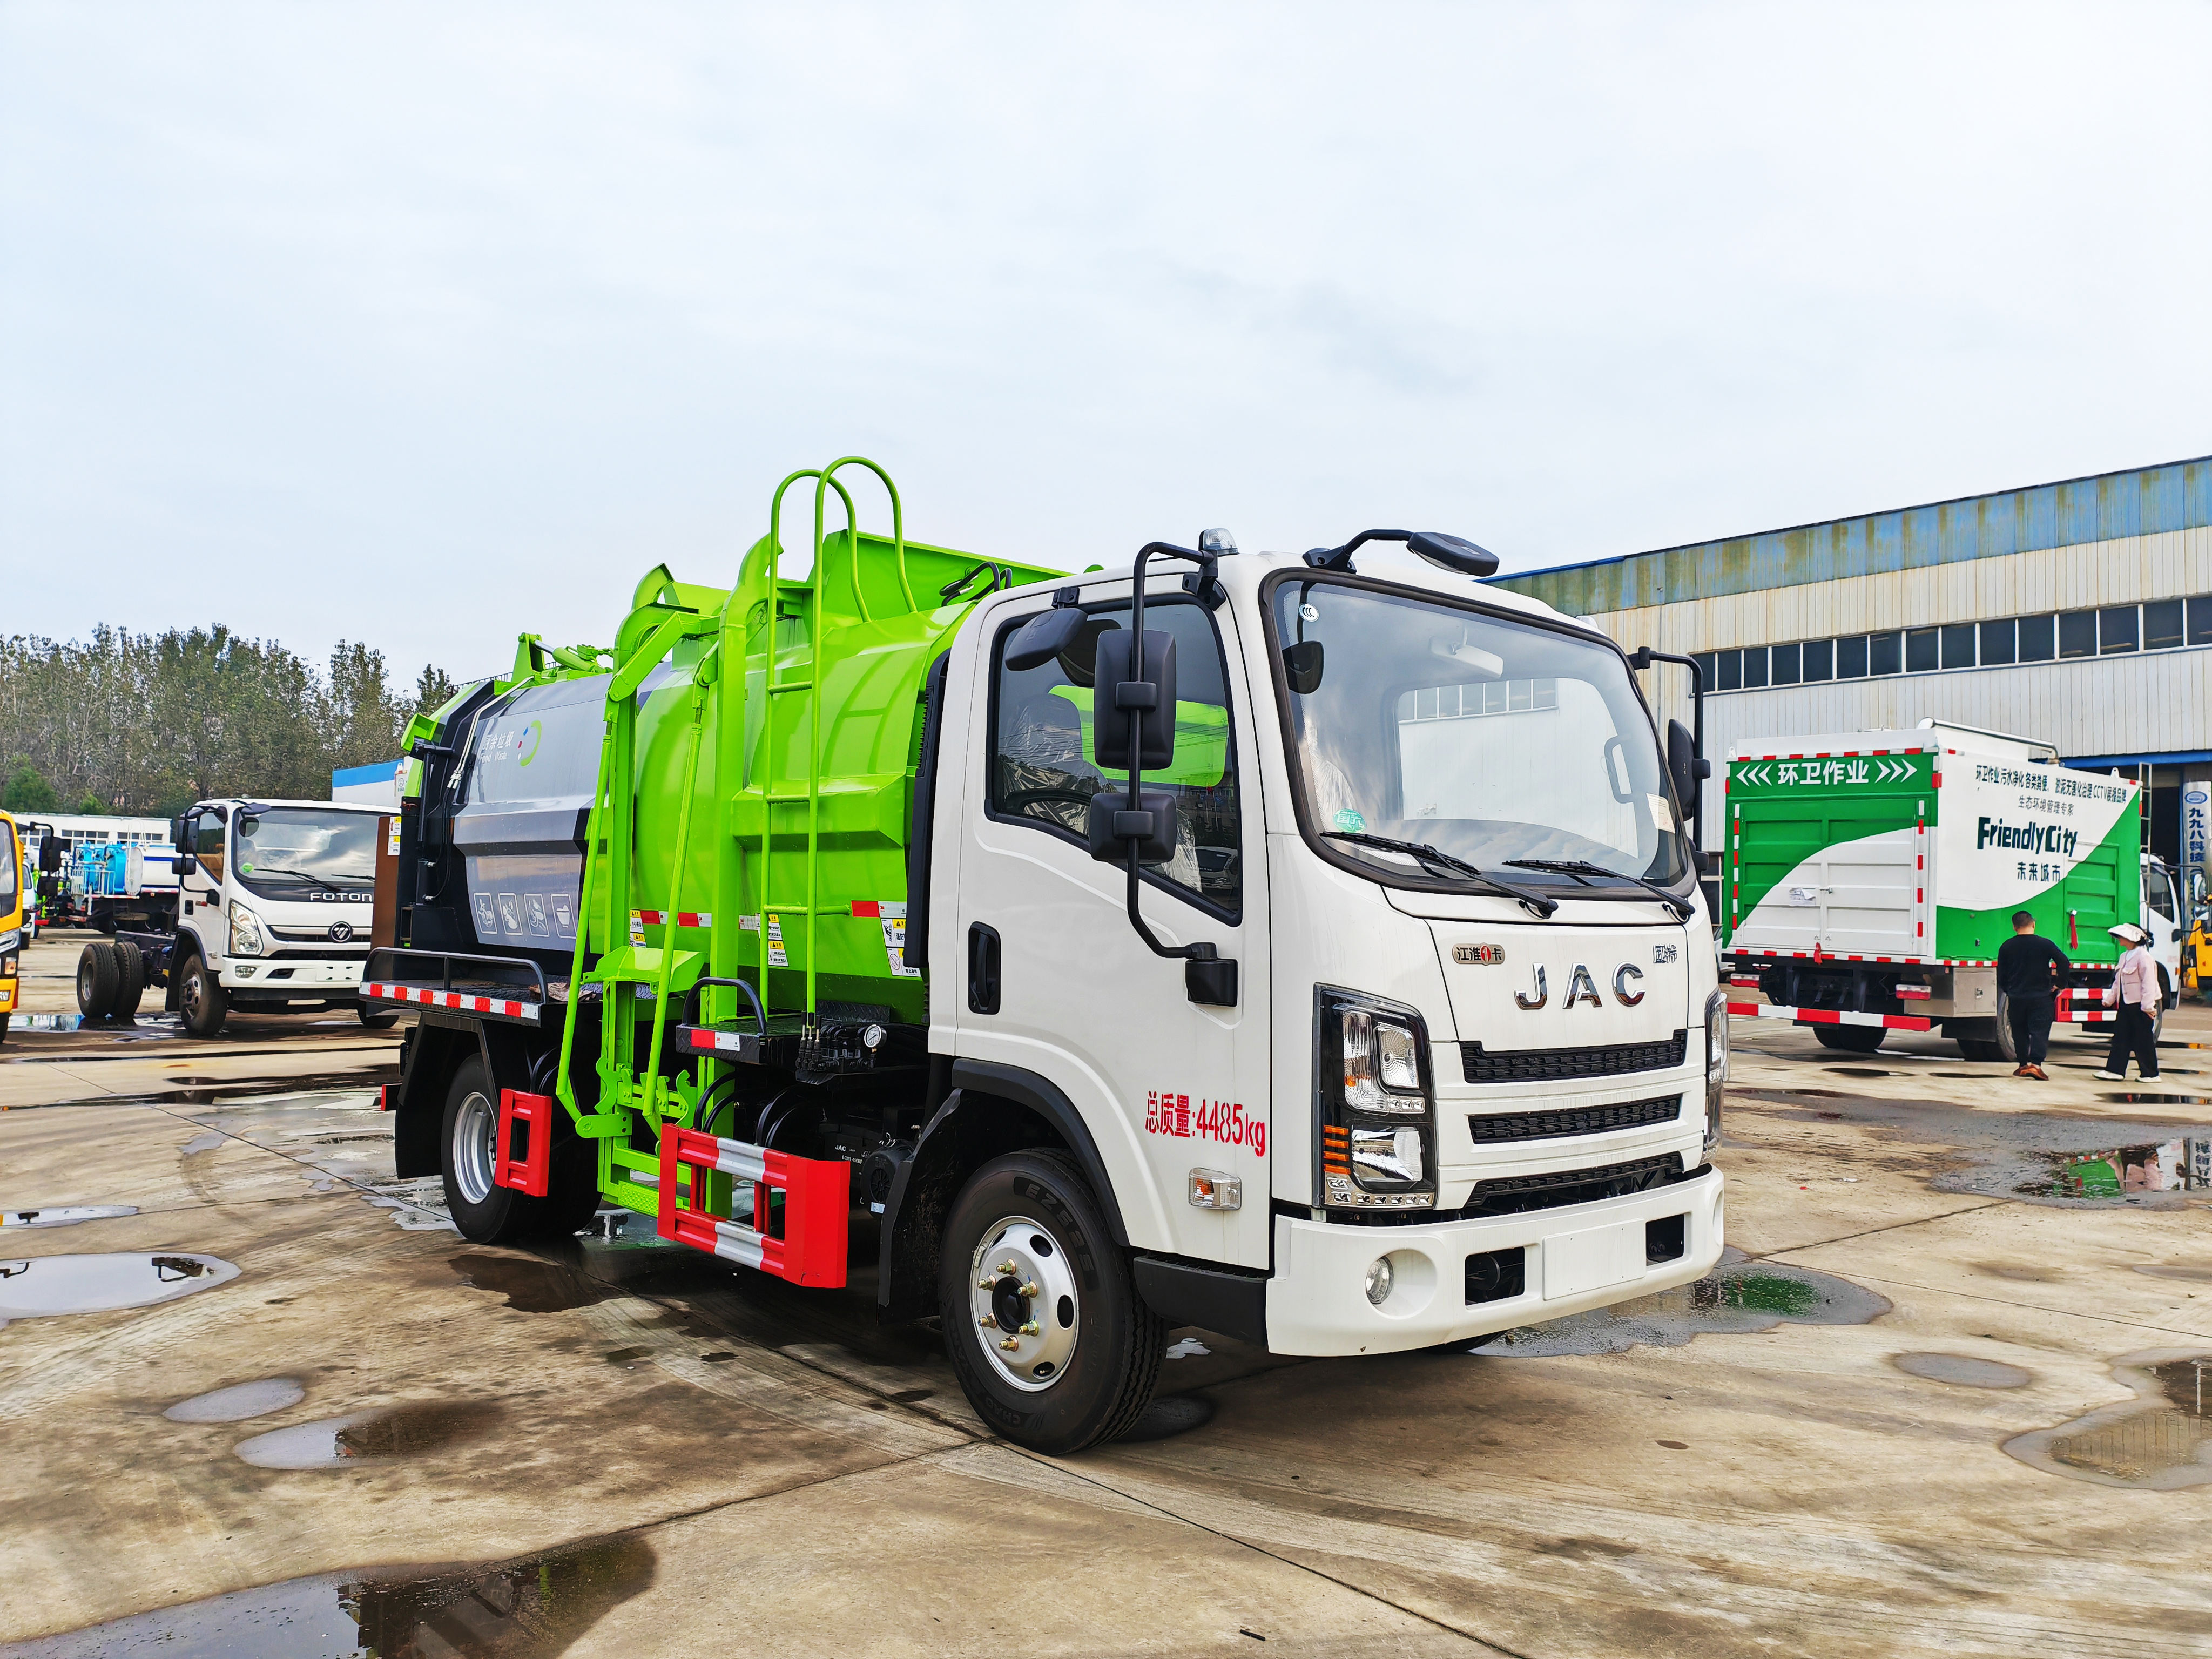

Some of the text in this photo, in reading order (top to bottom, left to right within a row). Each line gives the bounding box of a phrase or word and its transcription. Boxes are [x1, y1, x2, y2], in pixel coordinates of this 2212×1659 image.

[1777, 760, 1869, 786] 环卫作业
[1975, 765, 2000, 784] 环卫作业
[2018, 794, 2074, 817] 生态环境管理专家
[2017, 861, 2061, 882] 未来城市
[309, 892, 372, 902] FOTON
[1456, 945, 1502, 962] 江淮1卡
[1514, 961, 1645, 1010] JAC
